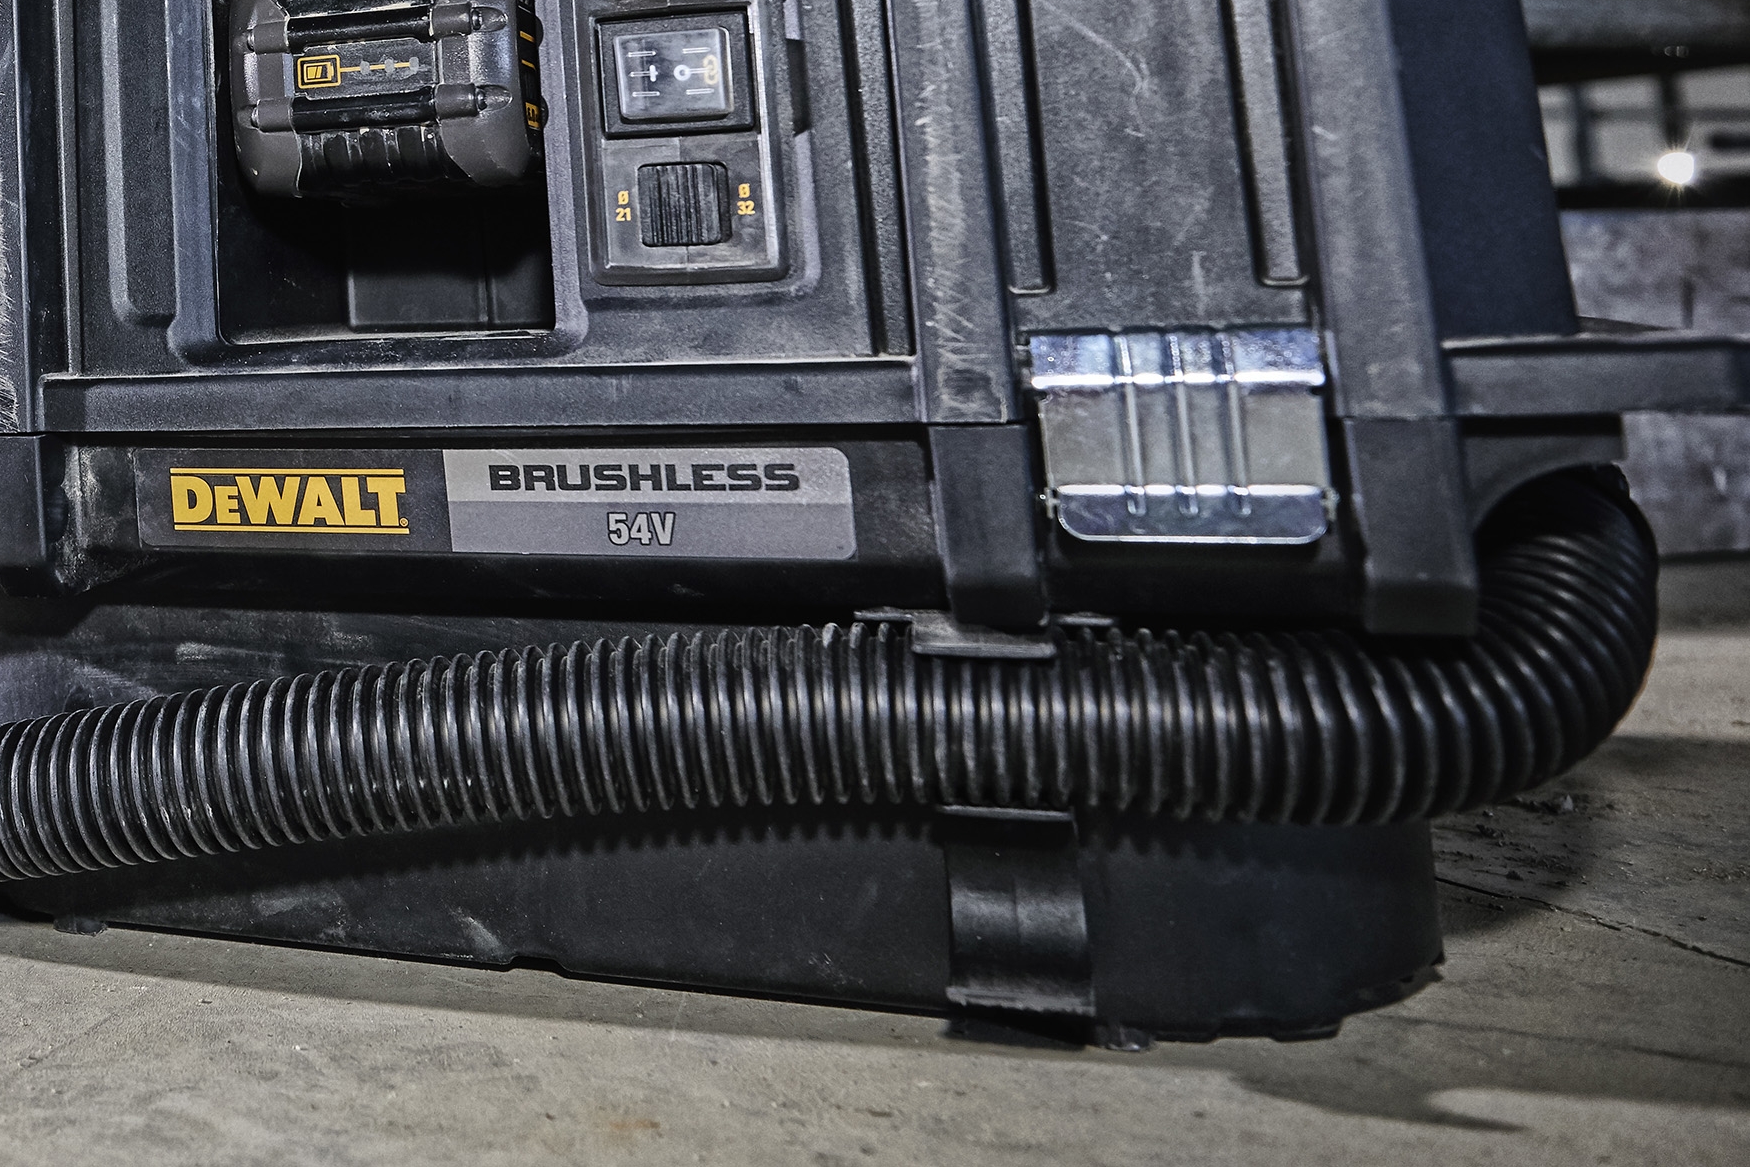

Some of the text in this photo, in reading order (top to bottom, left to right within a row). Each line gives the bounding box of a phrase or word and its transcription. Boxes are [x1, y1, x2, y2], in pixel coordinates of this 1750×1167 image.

[615, 207, 632, 222] 21
[736, 200, 756, 216] 32
[488, 464, 800, 492] BRUSHLESS
[606, 511, 677, 546] 54V
